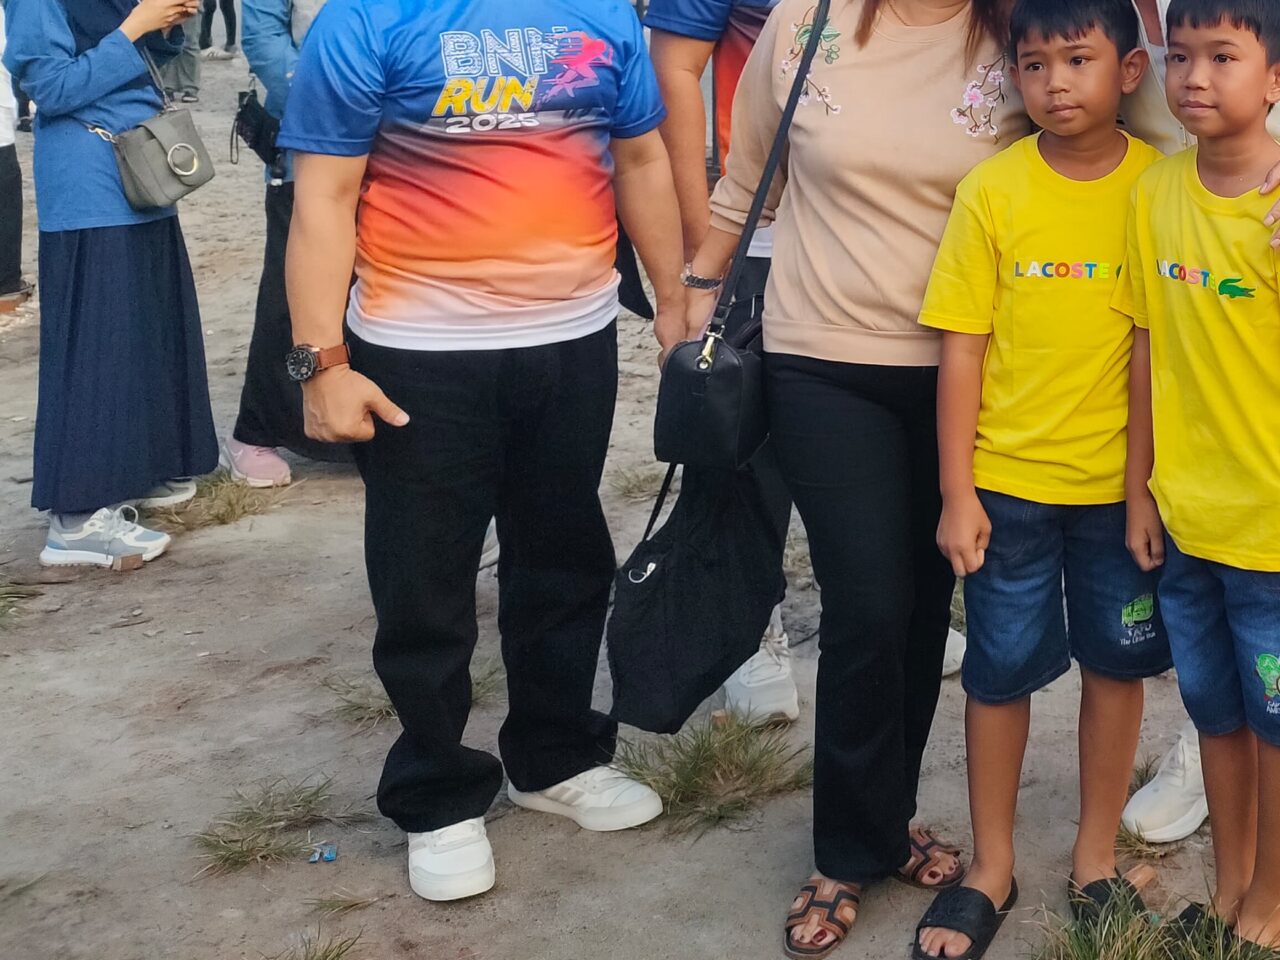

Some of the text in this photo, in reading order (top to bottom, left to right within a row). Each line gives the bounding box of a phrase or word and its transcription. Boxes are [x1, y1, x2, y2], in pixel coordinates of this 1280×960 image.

[431, 76, 540, 117] RUN
[445, 112, 541, 134] 2025
[1014, 261, 1110, 279] LACOSTE
